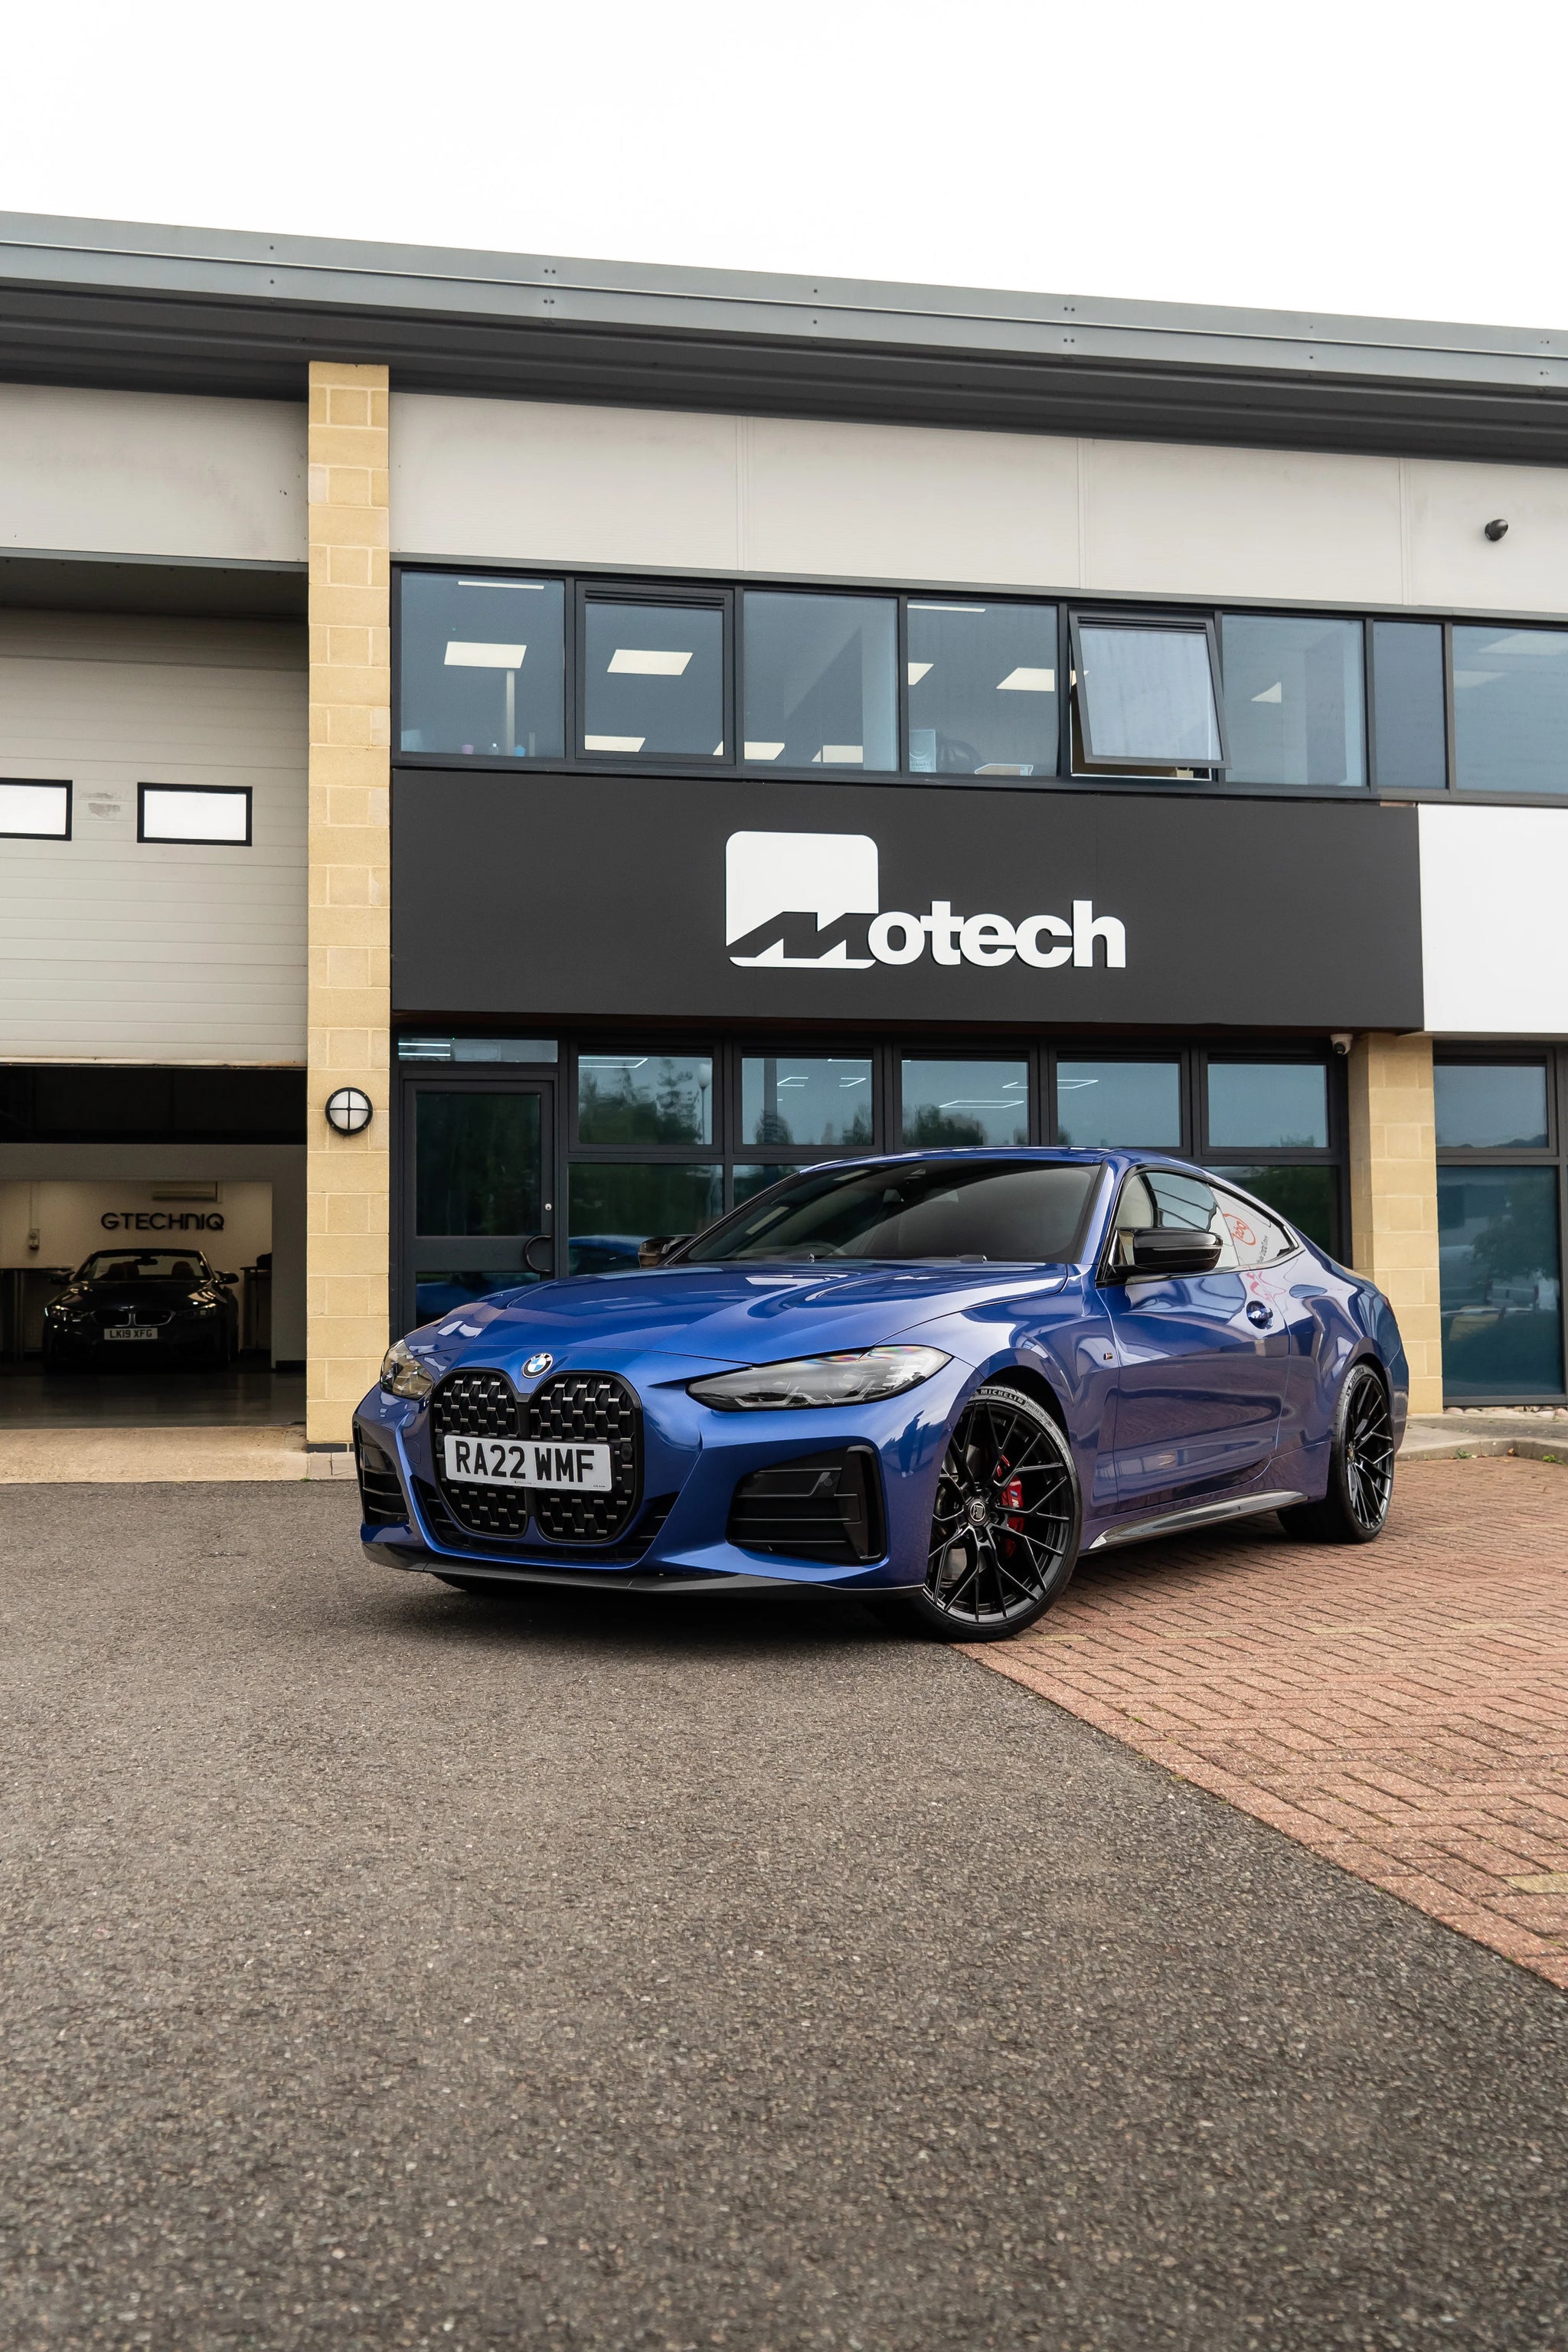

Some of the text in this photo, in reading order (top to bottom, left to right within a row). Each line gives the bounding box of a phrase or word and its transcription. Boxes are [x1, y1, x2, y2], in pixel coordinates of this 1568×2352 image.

[100, 1212, 224, 1230] GTECHNIQ
[109, 1328, 152, 1338] LK19 XFG
[981, 1388, 1024, 1403] MICHELIN
[455, 1440, 595, 1483] RA22 WMF
